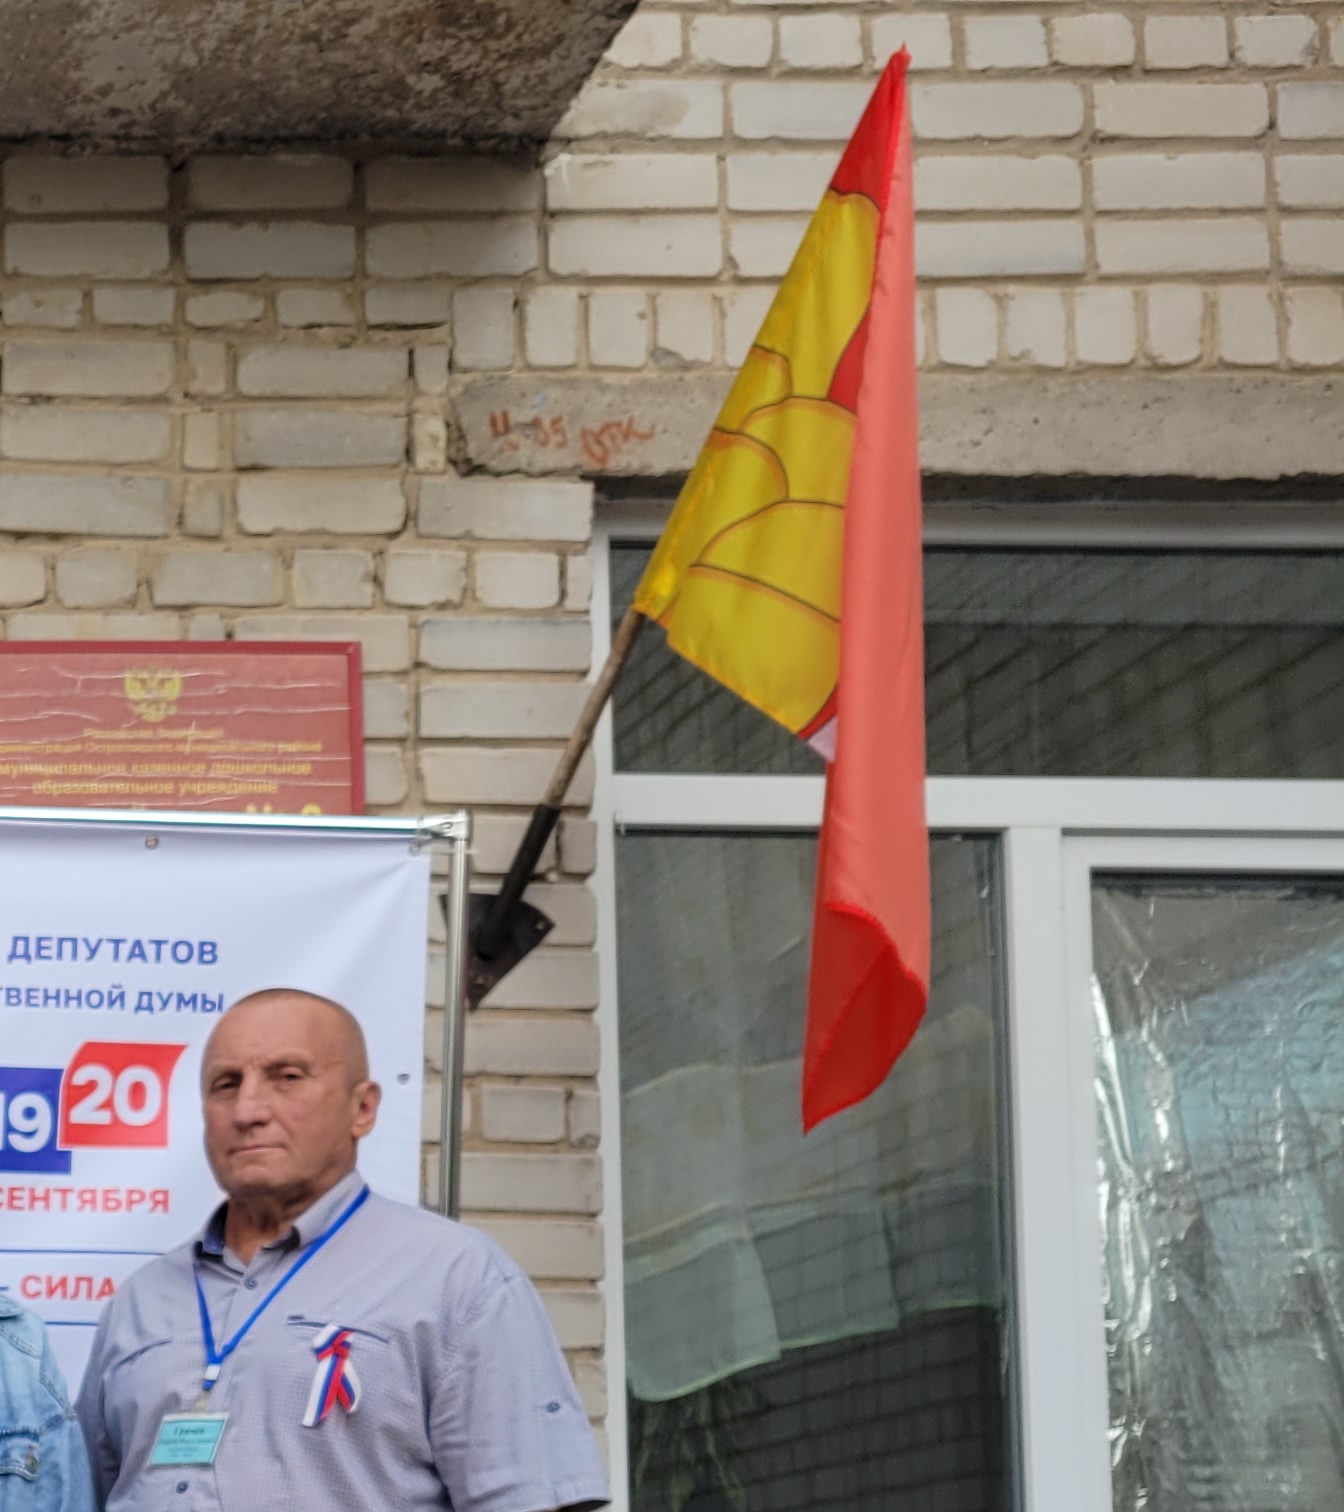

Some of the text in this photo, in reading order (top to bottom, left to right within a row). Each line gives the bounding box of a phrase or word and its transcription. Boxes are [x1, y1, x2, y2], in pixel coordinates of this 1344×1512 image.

[32, 780, 279, 797] образовательное учреждение
[7, 935, 219, 965] ДЕПУТАТОВ
[134, 991, 224, 1014] ДУМЫ
[69, 1064, 162, 1126] 20
[20, 1274, 116, 1301] СИЛА
